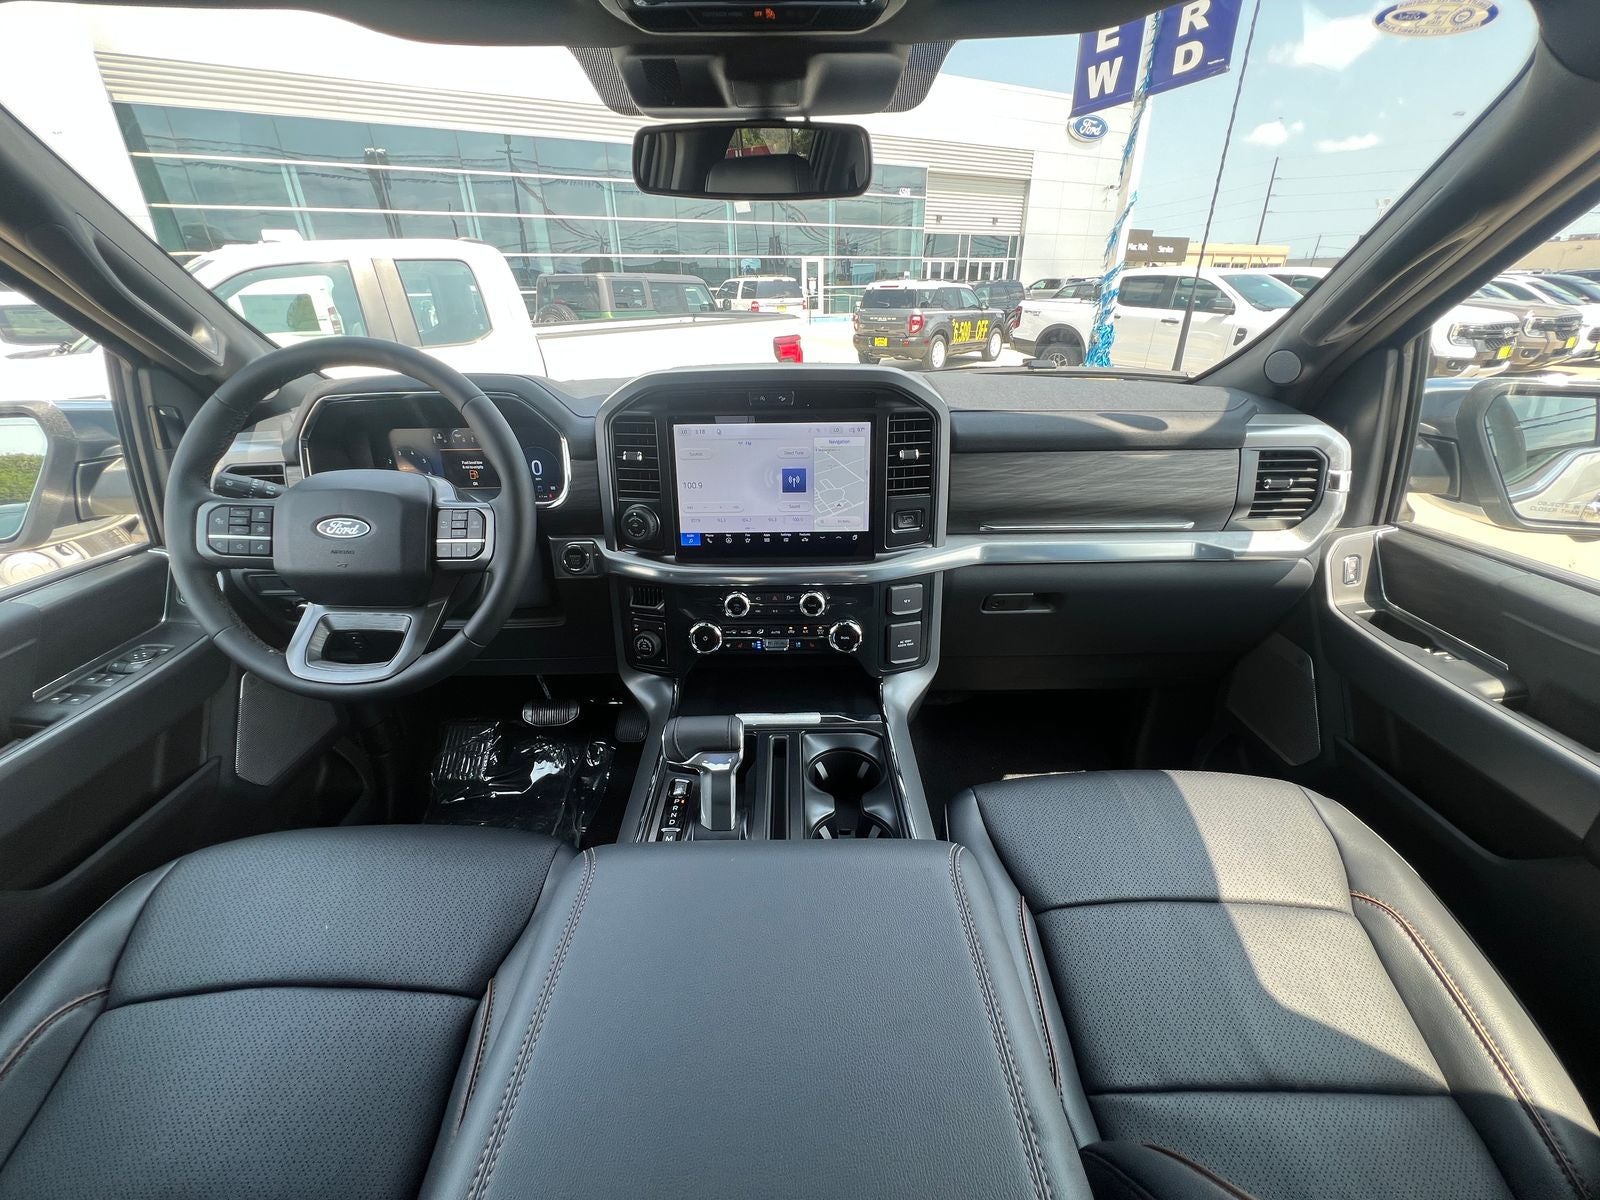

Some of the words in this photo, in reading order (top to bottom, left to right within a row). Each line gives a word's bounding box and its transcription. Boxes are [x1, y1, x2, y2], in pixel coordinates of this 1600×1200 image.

[1079, 118, 1104, 137] Ford
[531, 459, 543, 476] 0
[683, 481, 703, 489] 100.9
[325, 520, 361, 535] Ford
